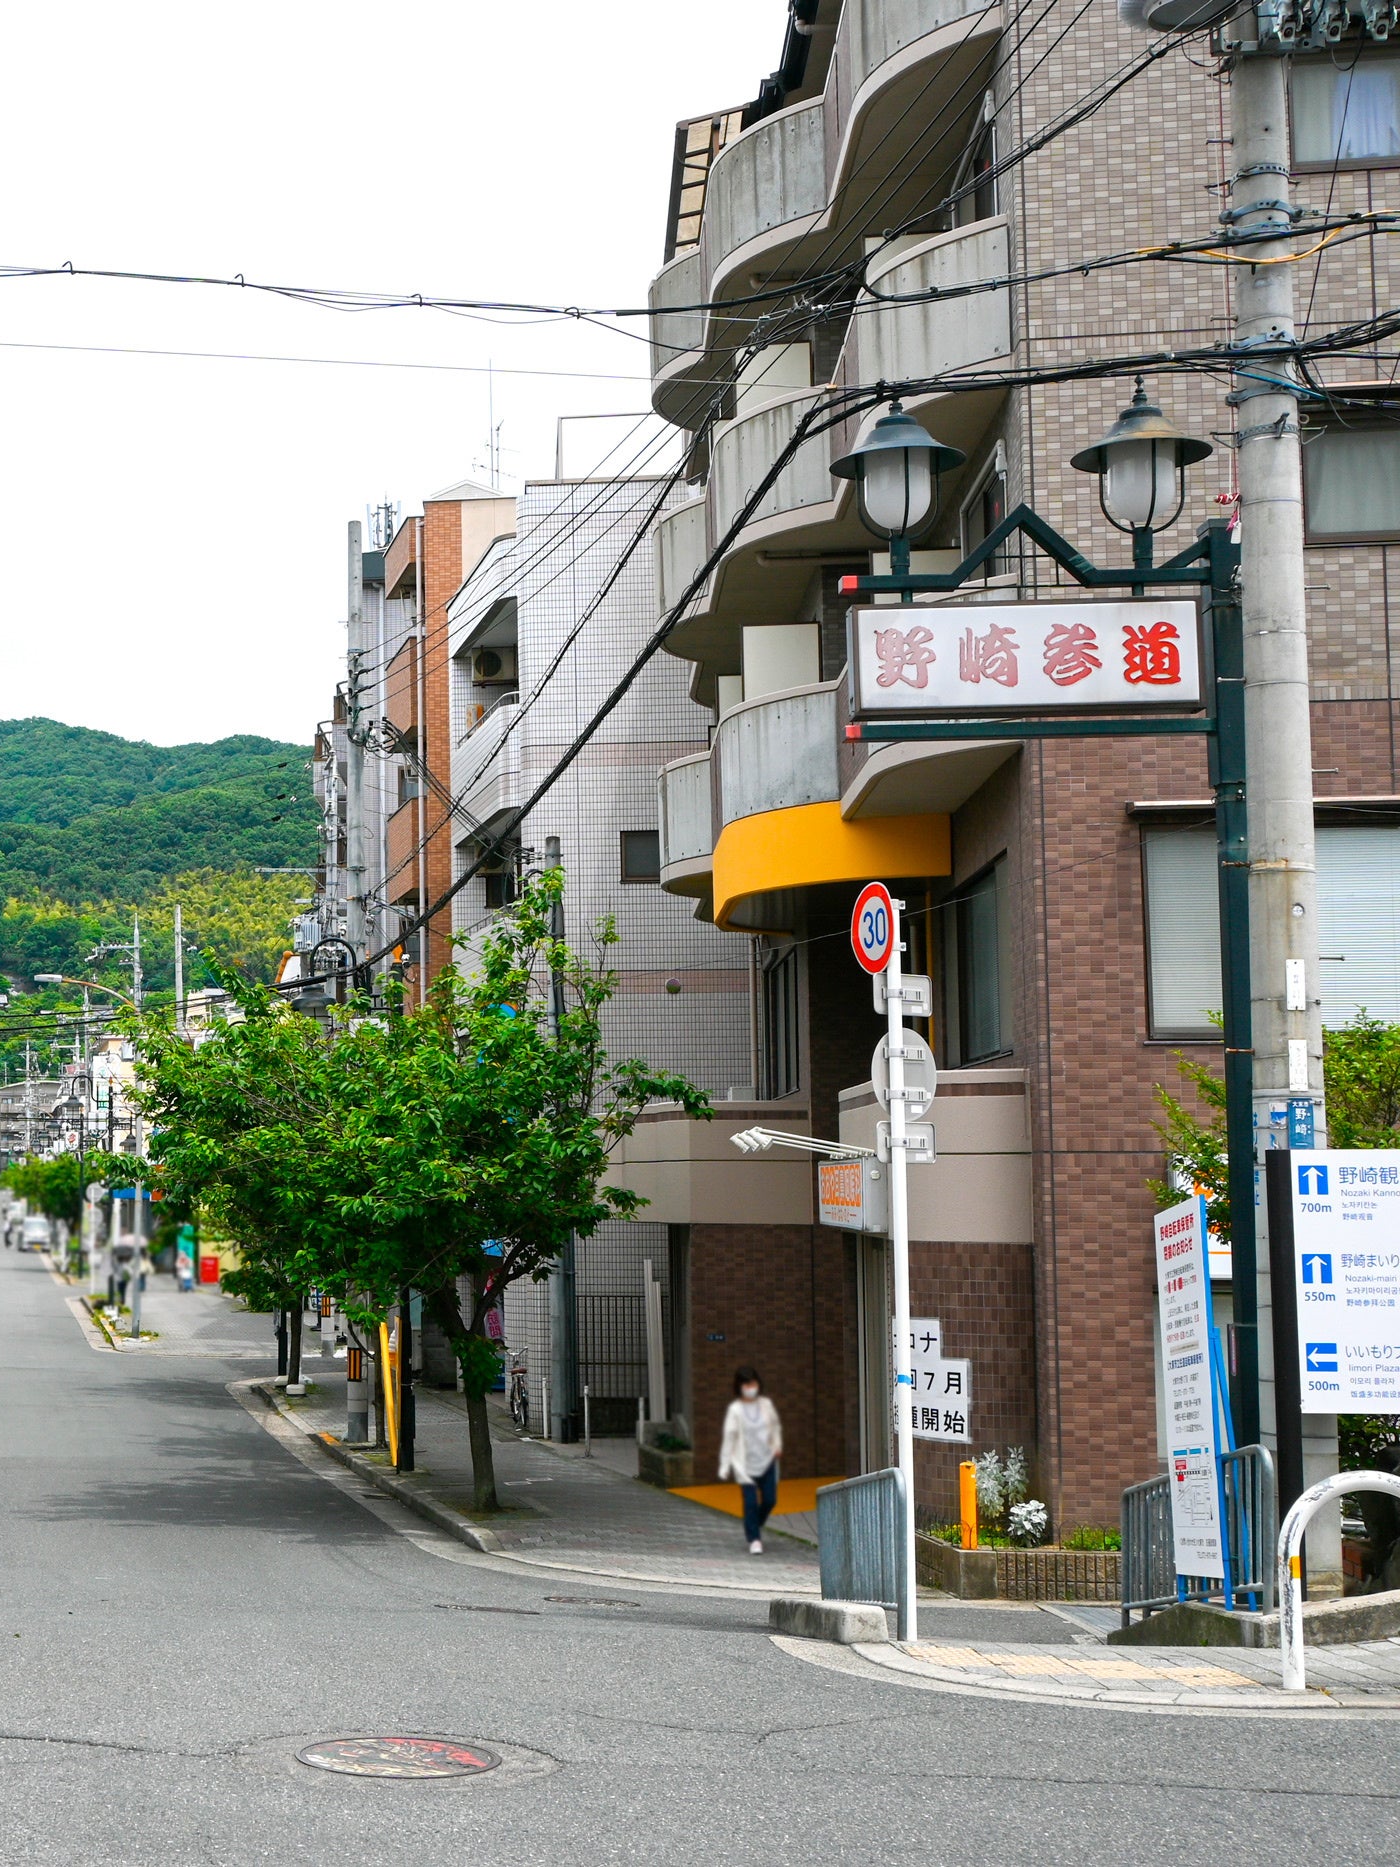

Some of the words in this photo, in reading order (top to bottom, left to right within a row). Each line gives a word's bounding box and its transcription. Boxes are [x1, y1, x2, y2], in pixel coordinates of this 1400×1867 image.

[863, 908, 886, 949] 30
[1339, 1166, 1399, 1184] 野崎観
[1341, 1189, 1371, 1197] Nozaki
[1300, 1203, 1332, 1213] 700m
[1341, 1254, 1400, 1268] 野崎まいり
[1304, 1291, 1336, 1301] 550m
[1345, 1286, 1400, 1296] 노자키마이리공
[1375, 1364, 1400, 1372] Plaza
[1308, 1381, 1340, 1391] 500m
